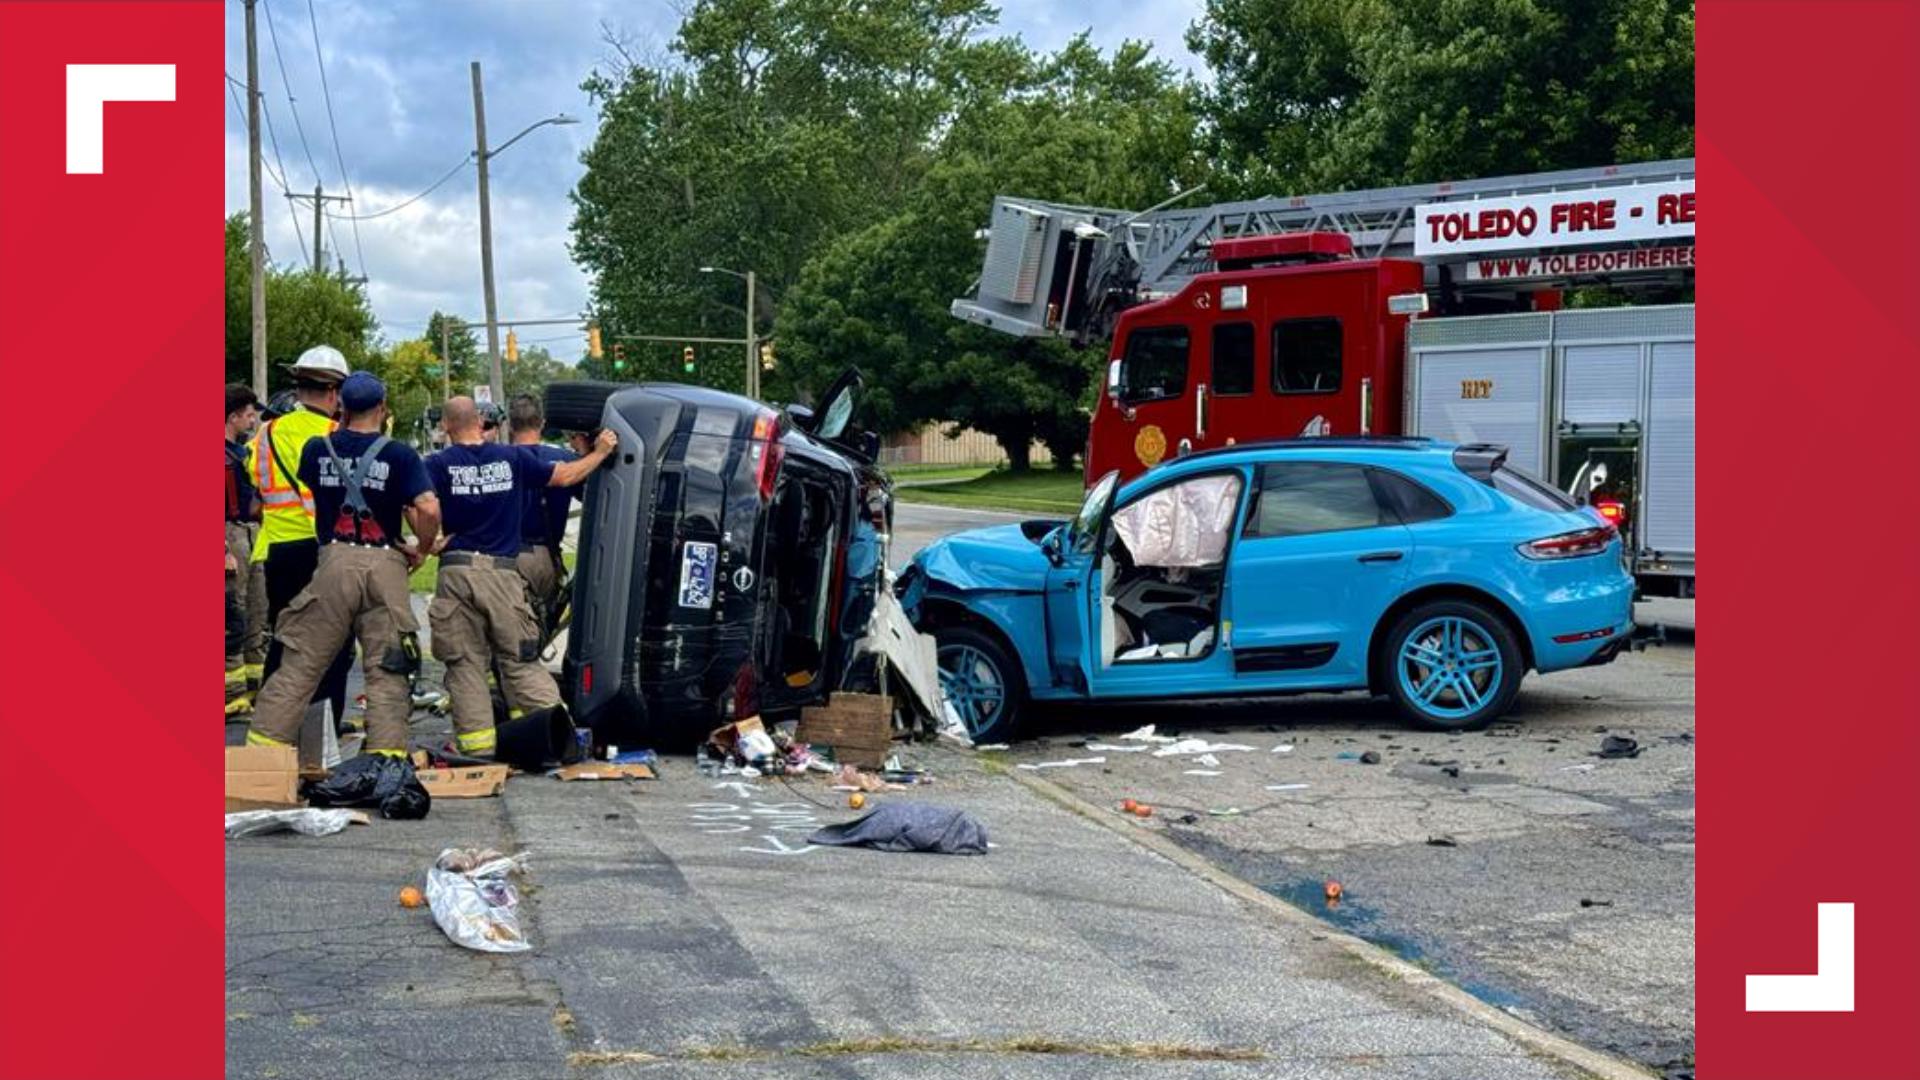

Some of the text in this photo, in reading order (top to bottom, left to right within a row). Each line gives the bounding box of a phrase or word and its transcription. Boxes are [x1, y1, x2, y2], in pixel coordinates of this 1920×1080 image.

[1426, 206, 1538, 243] TOLEDO
[1550, 200, 1616, 233] FIRE
[448, 461, 512, 486] TOLEDO
